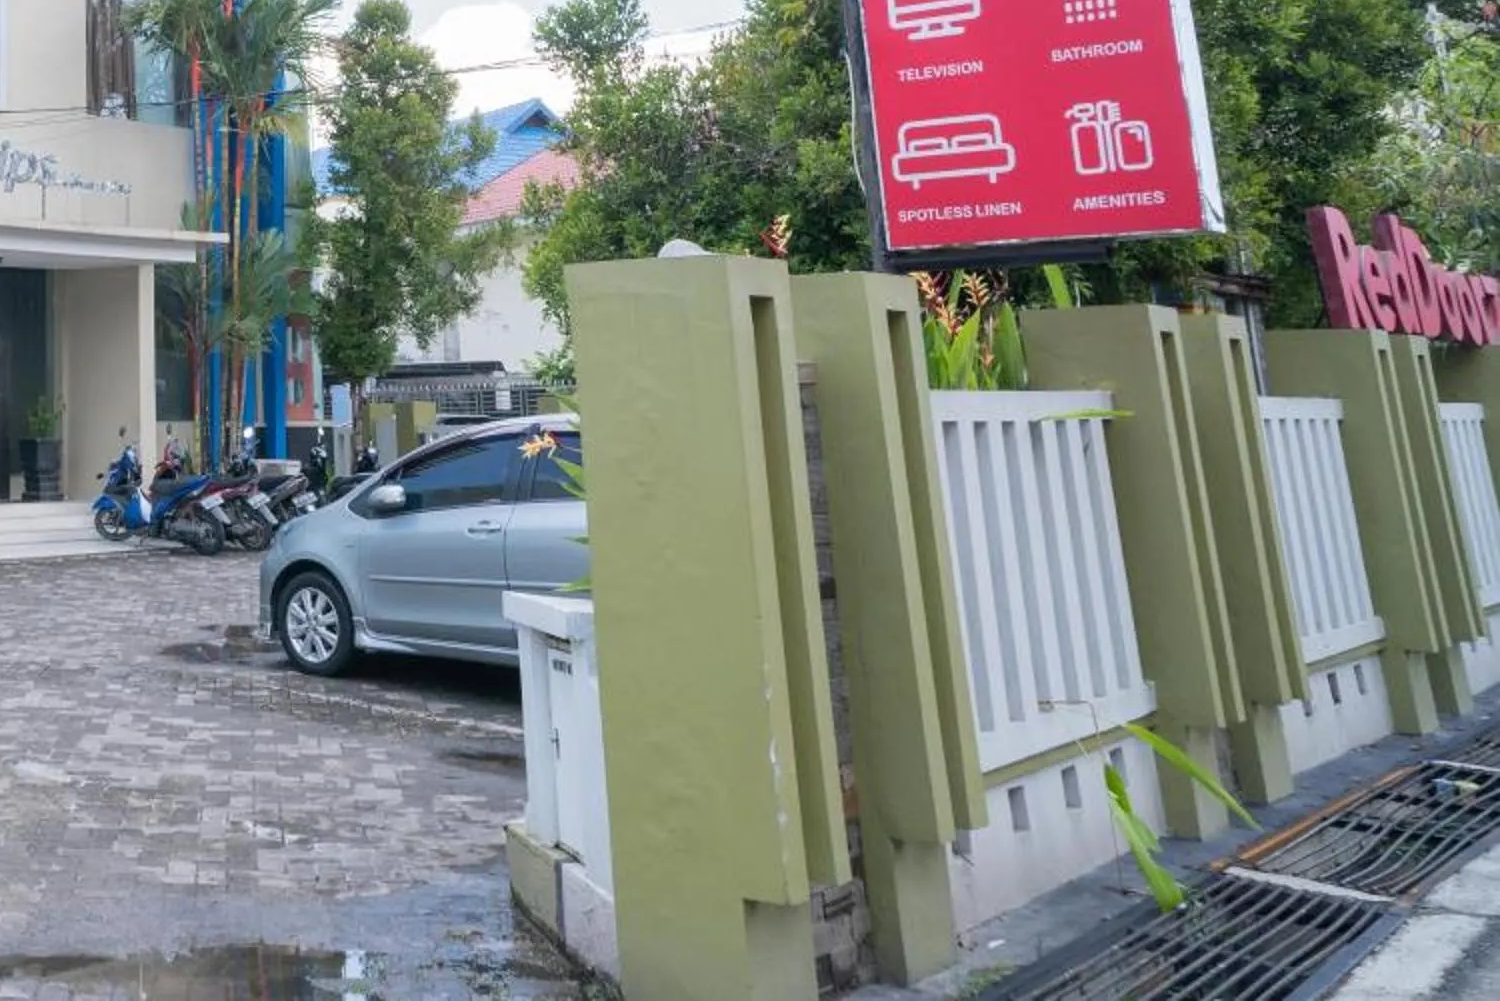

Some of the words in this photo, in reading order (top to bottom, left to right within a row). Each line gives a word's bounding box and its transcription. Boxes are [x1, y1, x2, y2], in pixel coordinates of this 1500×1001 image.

[1051, 39, 1143, 62] BATHROOM
[898, 60, 984, 83] TELEVISION
[898, 203, 973, 223] SPOTLESS
[975, 200, 1022, 218] LINEN
[1073, 190, 1166, 212] AMENITIES
[1306, 205, 1500, 346] RedDoor
